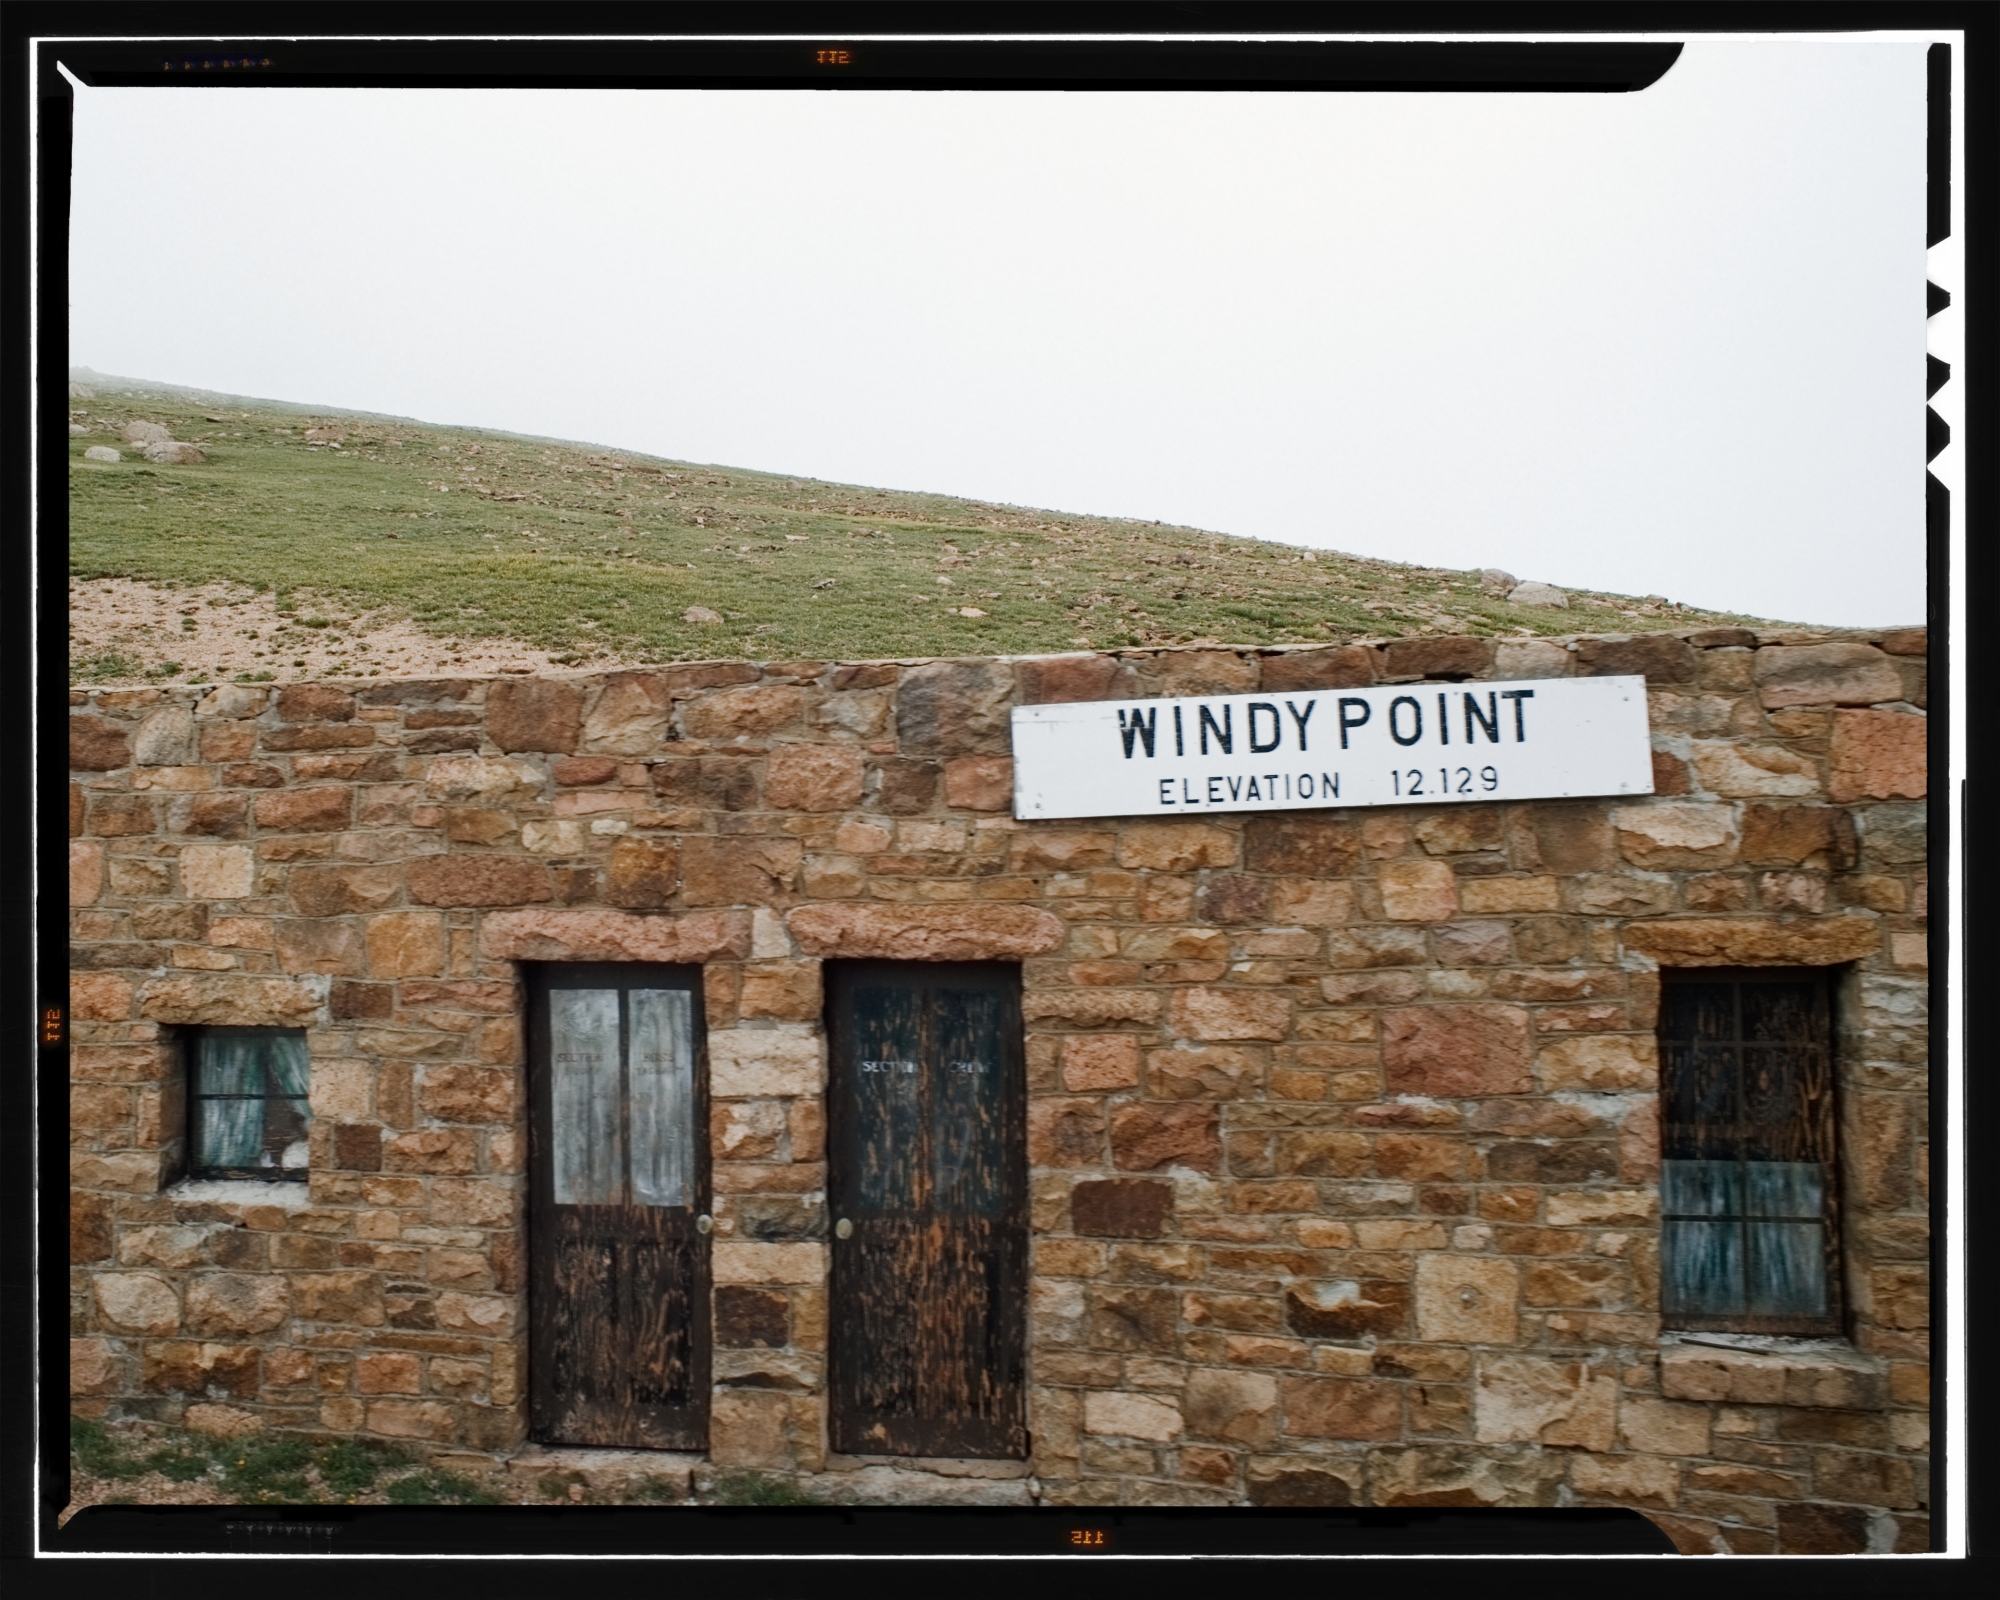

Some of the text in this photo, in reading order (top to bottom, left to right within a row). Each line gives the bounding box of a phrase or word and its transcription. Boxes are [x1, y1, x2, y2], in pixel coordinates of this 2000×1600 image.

[1118, 689, 1534, 759] WINDY POINT
[1159, 766, 1499, 805] ELEVATION 12.129
